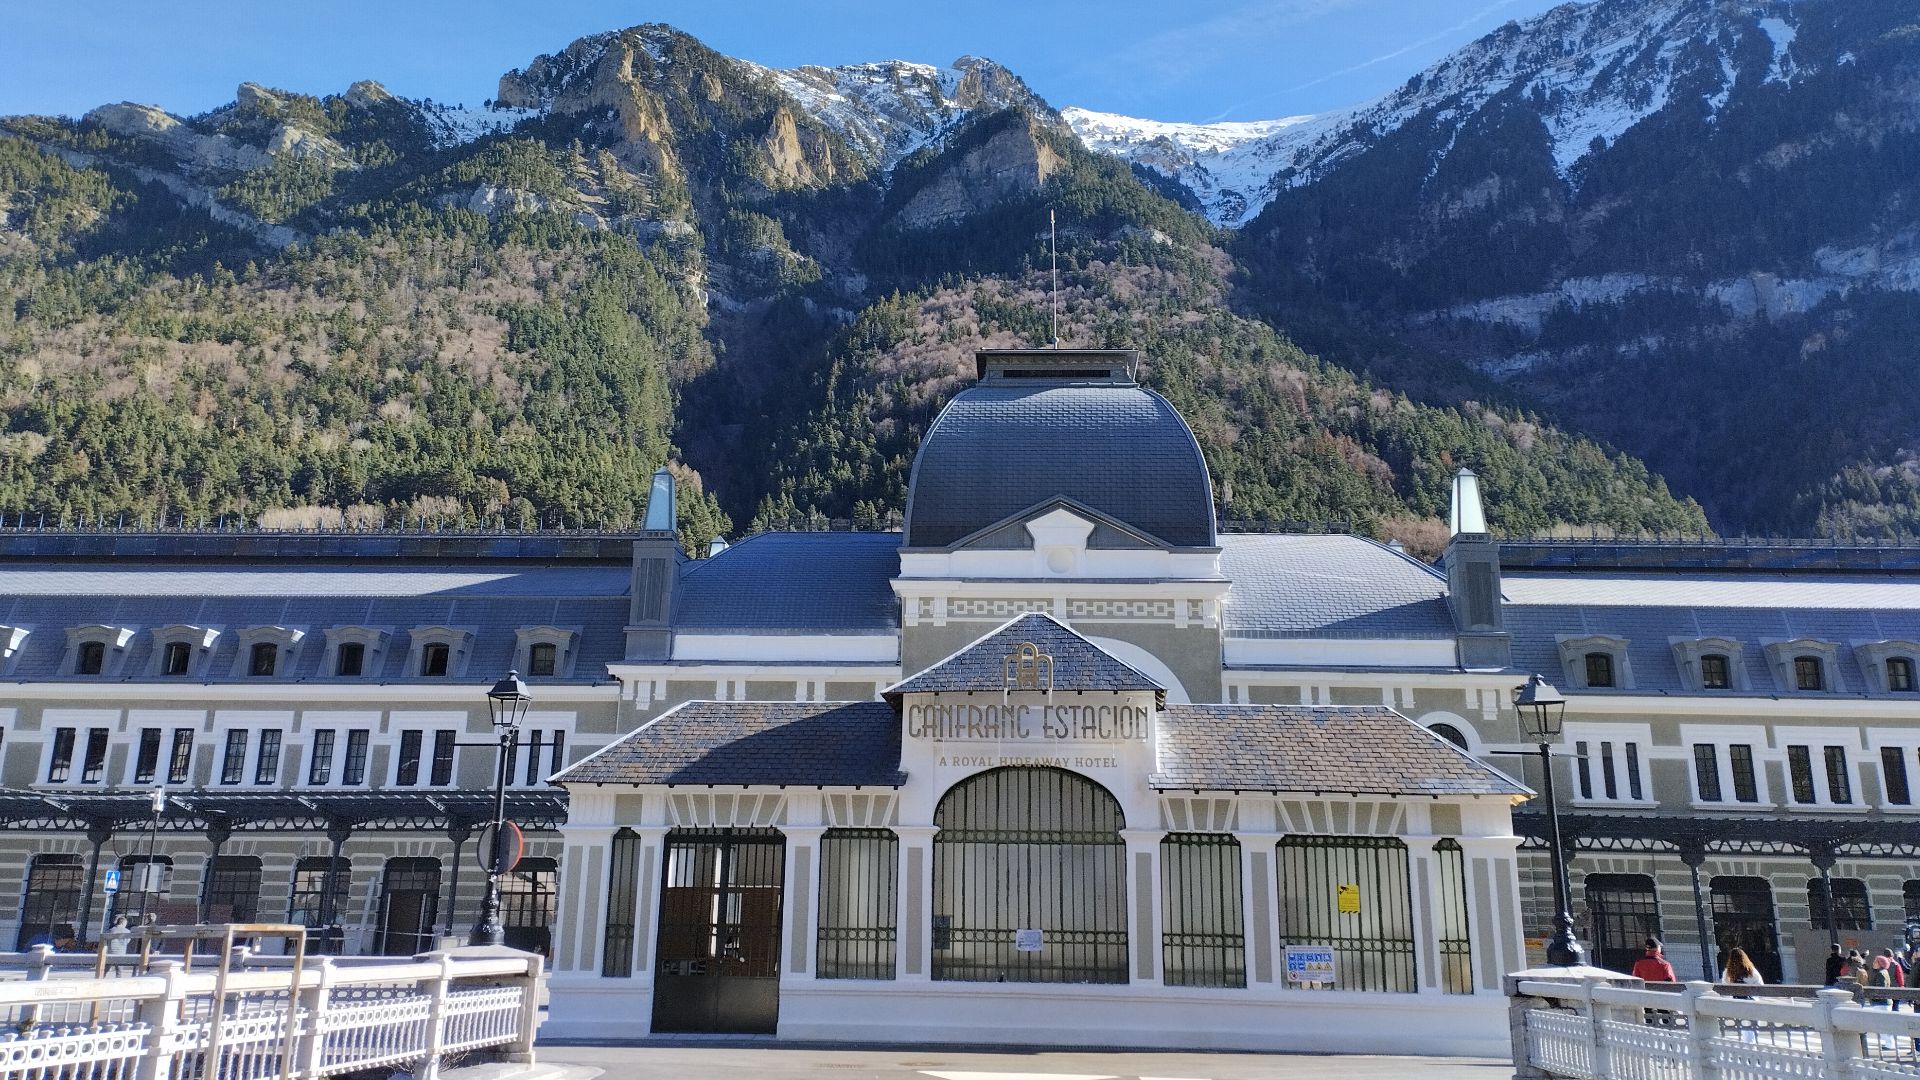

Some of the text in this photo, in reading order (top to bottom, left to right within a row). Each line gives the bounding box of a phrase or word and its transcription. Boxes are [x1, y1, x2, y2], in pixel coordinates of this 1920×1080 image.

[908, 698, 1148, 739] CANFRANC ESTACIÓN
[939, 756, 1118, 768] A ROYAL HIDEAWAY HOTEL
